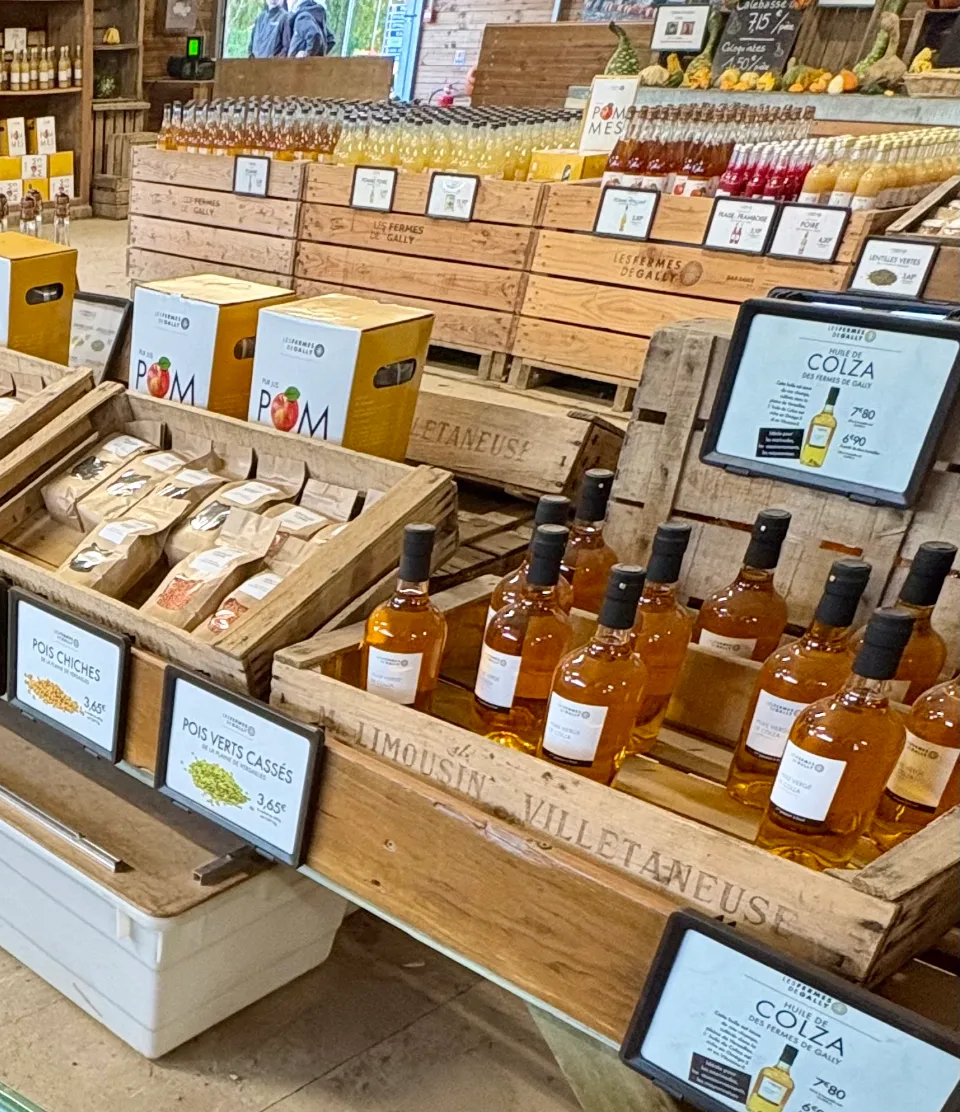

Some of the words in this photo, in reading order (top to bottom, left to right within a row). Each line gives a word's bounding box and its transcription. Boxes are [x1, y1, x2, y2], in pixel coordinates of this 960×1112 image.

[589, 121, 624, 135] MES
[387, 233, 415, 244] GALLY
[388, 222, 424, 235] FERMES
[829, 348, 850, 357] HUILE
[851, 351, 862, 359] DE
[807, 353, 875, 380] COLZA
[802, 372, 814, 380] DES
[815, 374, 840, 384] FERMES
[841, 377, 850, 386] DE
[852, 379, 872, 389] GALLY
[32, 637, 54, 660] POIS
[56, 647, 102, 682] CHICHES
[83, 696, 106, 715] 3,65€
[182, 717, 208, 741] POIS
[210, 731, 244, 762] VERTS
[245, 751, 294, 785] CASSÉS
[256, 793, 287, 815] 3,65€
[355, 721, 487, 802] LIMOUSIN
[522, 792, 800, 939] VILLETANEUSE
[783, 1002, 812, 1020] HUILE
[814, 1015, 829, 1028] DE
[748, 1014, 765, 1027] DES
[766, 1023, 798, 1044] FERMES
[800, 1040, 813, 1051] DE
[814, 1049, 842, 1065] GALLY
[755, 1000, 844, 1057] COLZA
[812, 1076, 846, 1100] 7€80
